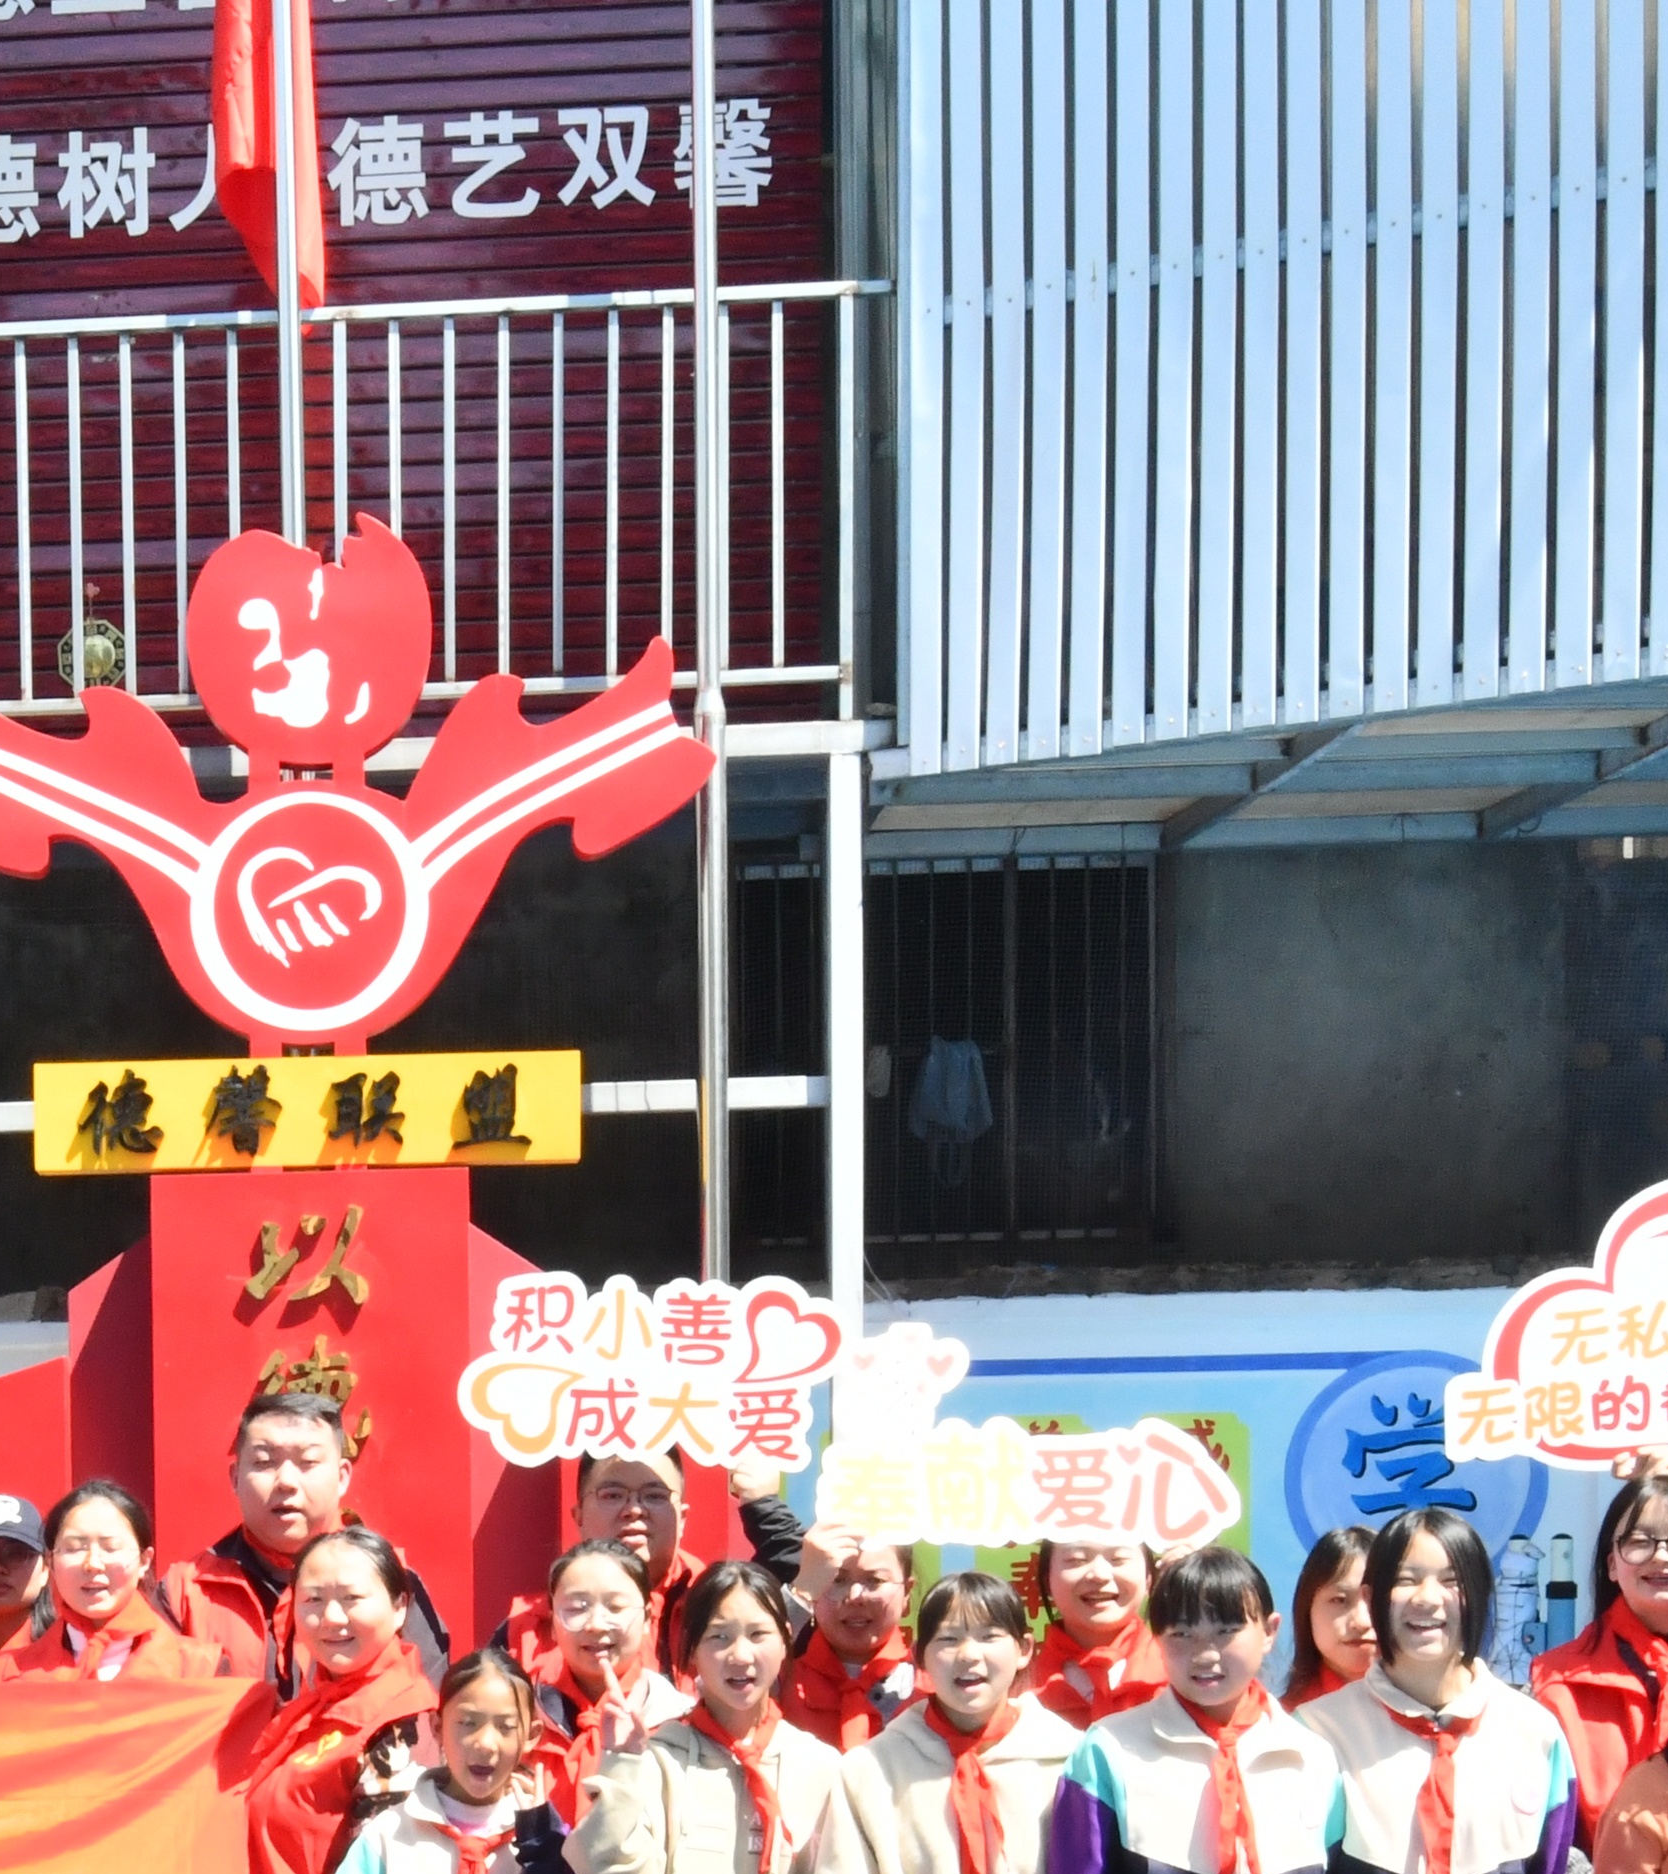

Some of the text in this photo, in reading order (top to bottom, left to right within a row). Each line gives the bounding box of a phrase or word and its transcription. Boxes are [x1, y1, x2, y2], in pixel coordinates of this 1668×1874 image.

[327, 98, 773, 227] 德艺双馨
[502, 1285, 732, 1365] 积小善
[565, 1377, 801, 1461] 成大爱
